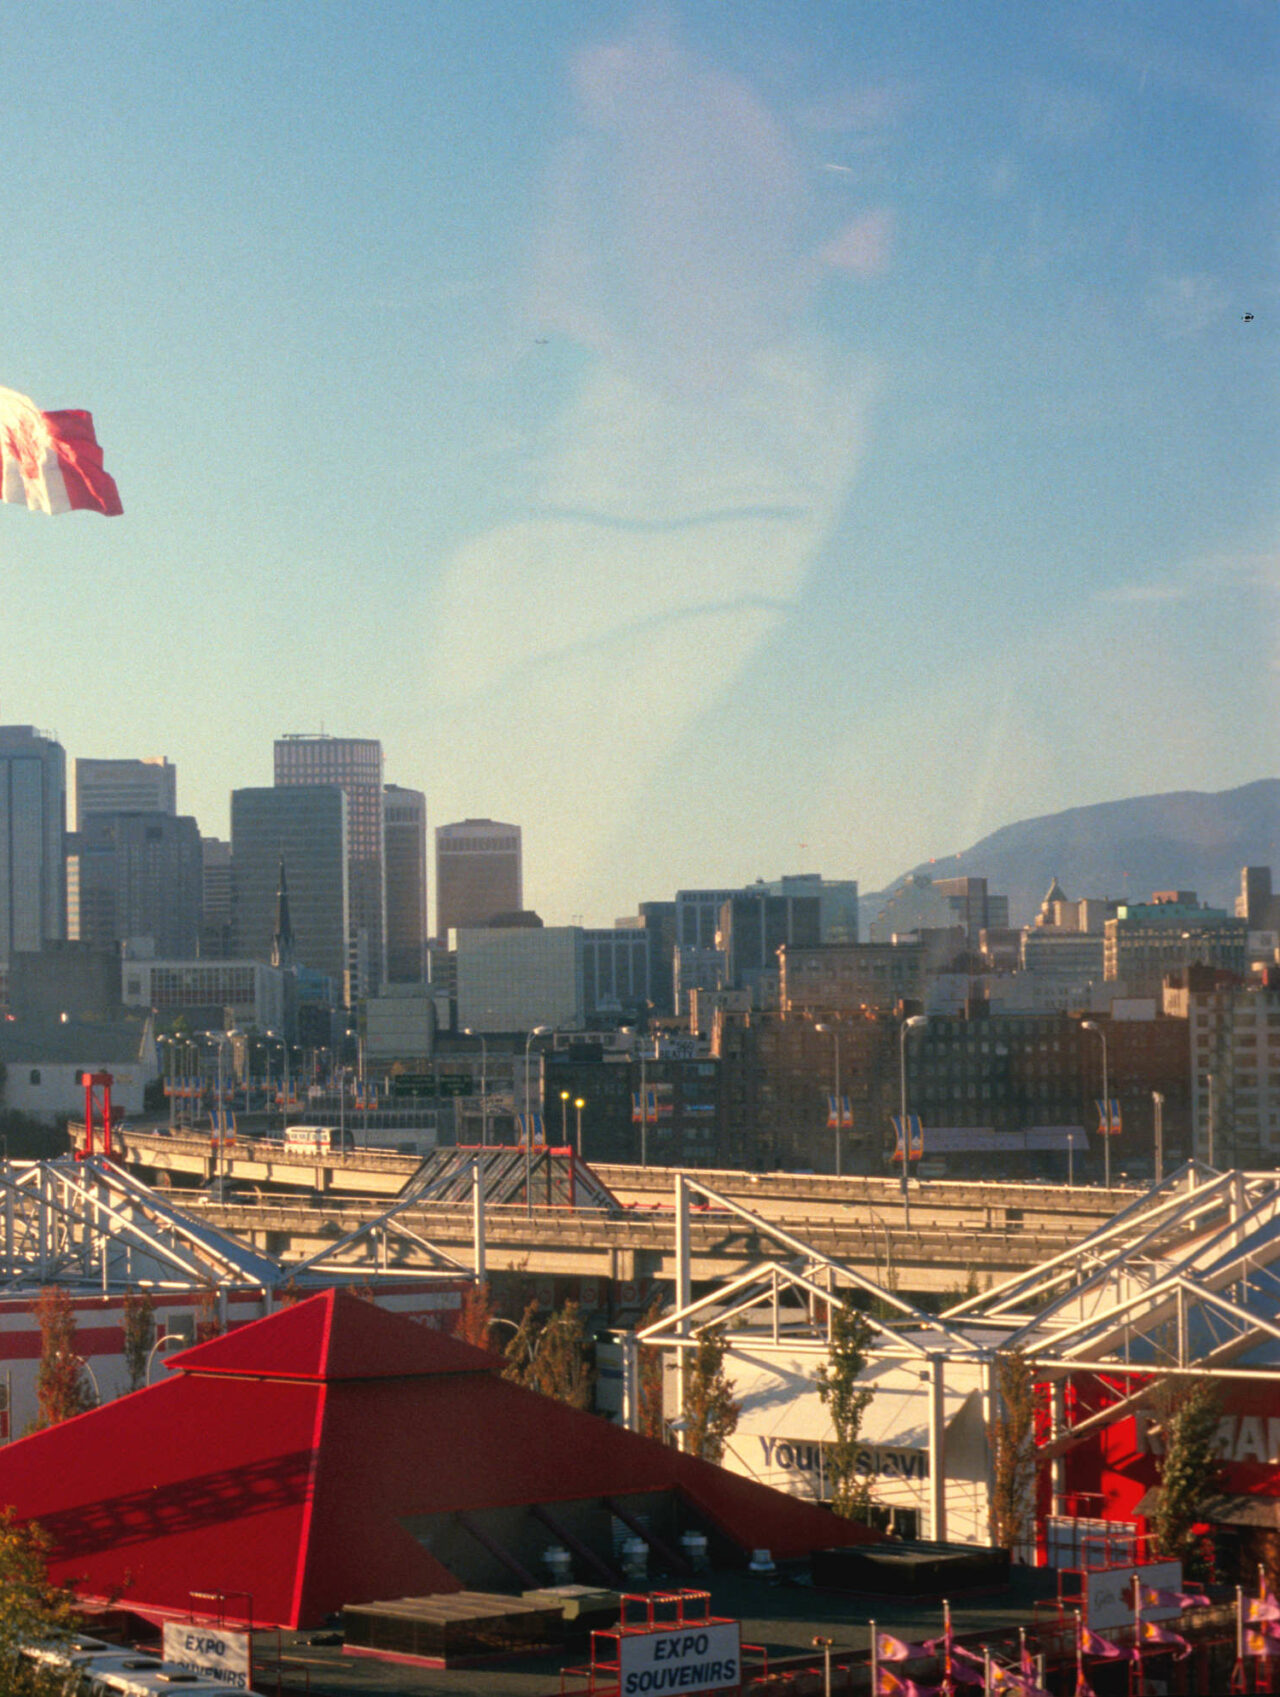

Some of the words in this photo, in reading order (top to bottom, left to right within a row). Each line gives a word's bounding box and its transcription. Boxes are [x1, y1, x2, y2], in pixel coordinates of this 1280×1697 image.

[185, 1634, 225, 1657] EXPO
[654, 1634, 708, 1661] EXPO
[625, 1659, 736, 1693] SOUVENIRS
